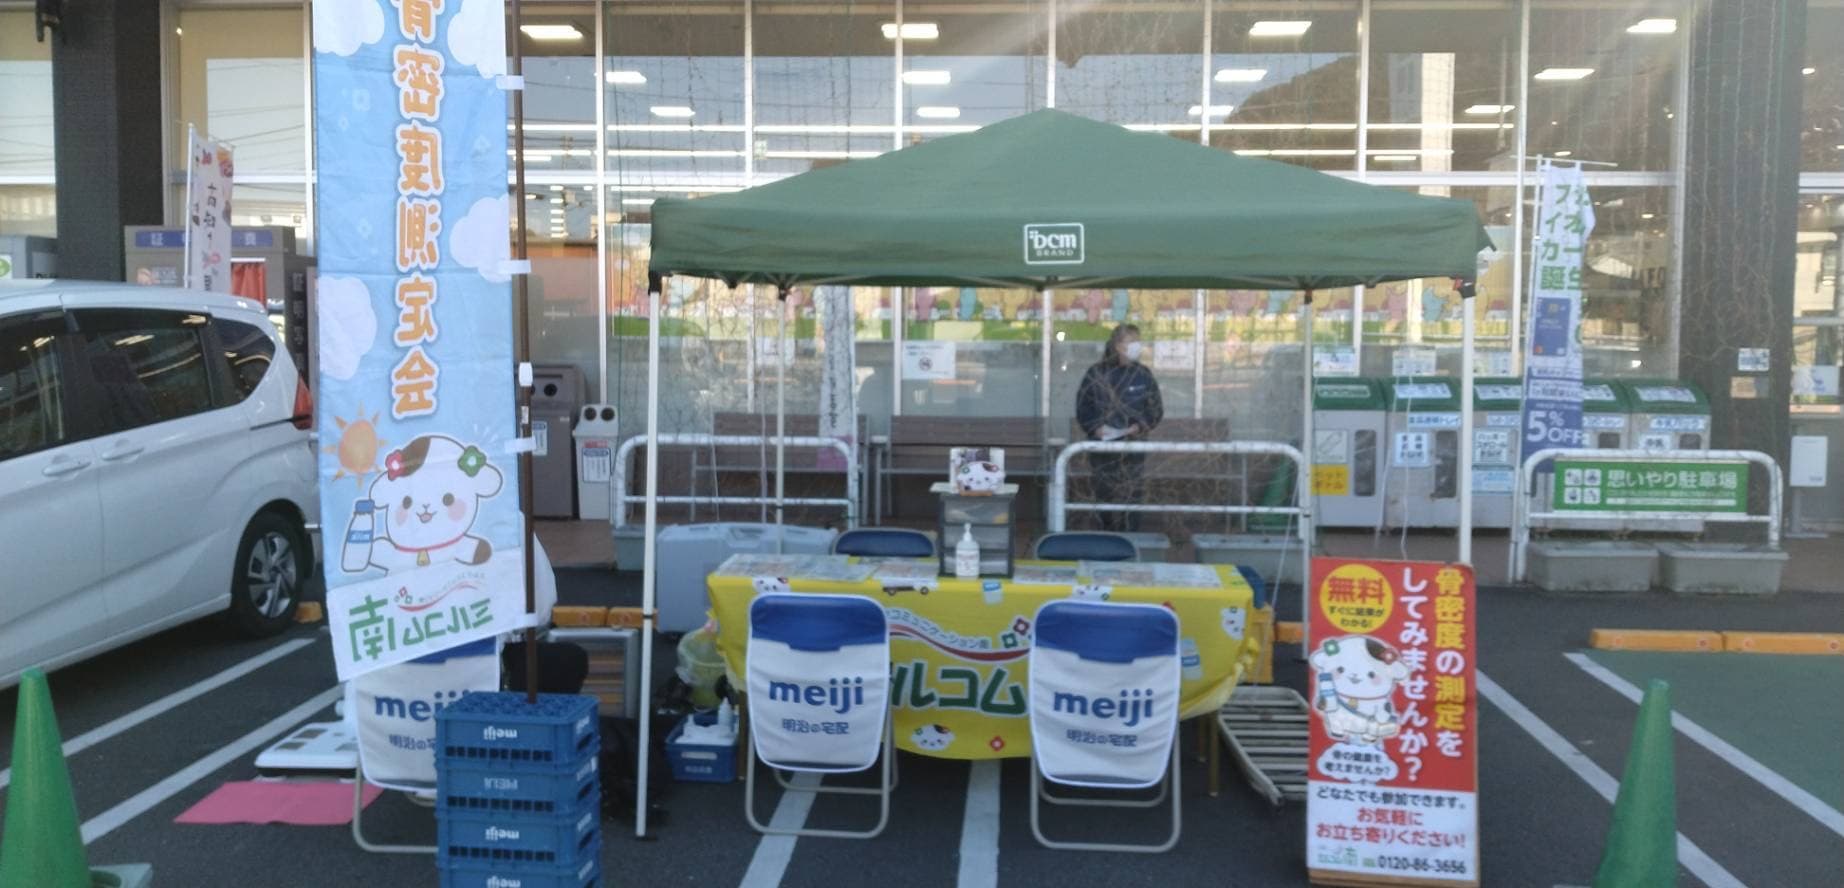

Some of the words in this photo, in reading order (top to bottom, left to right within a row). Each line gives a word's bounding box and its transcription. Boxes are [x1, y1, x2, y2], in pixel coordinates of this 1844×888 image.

[1035, 249, 1074, 257] BRAND
[1526, 410, 1565, 442] 5%
[1547, 427, 1583, 444] OFF
[1606, 469, 1738, 489] 思いやり駐車場
[1327, 577, 1386, 605] 無料
[1434, 568, 1466, 758] 骨密度の測定を
[1399, 566, 1429, 781] してみませんか?
[768, 676, 865, 714] meiji
[1053, 688, 1154, 727] meiji
[483, 725, 518, 740] meiji
[781, 718, 849, 735] 明治の宅配
[1066, 729, 1138, 747] 明治の宅配
[1316, 786, 1466, 809] どなたでも参加できます。
[1356, 806, 1424, 826] お気軽に
[485, 825, 519, 841] meiji
